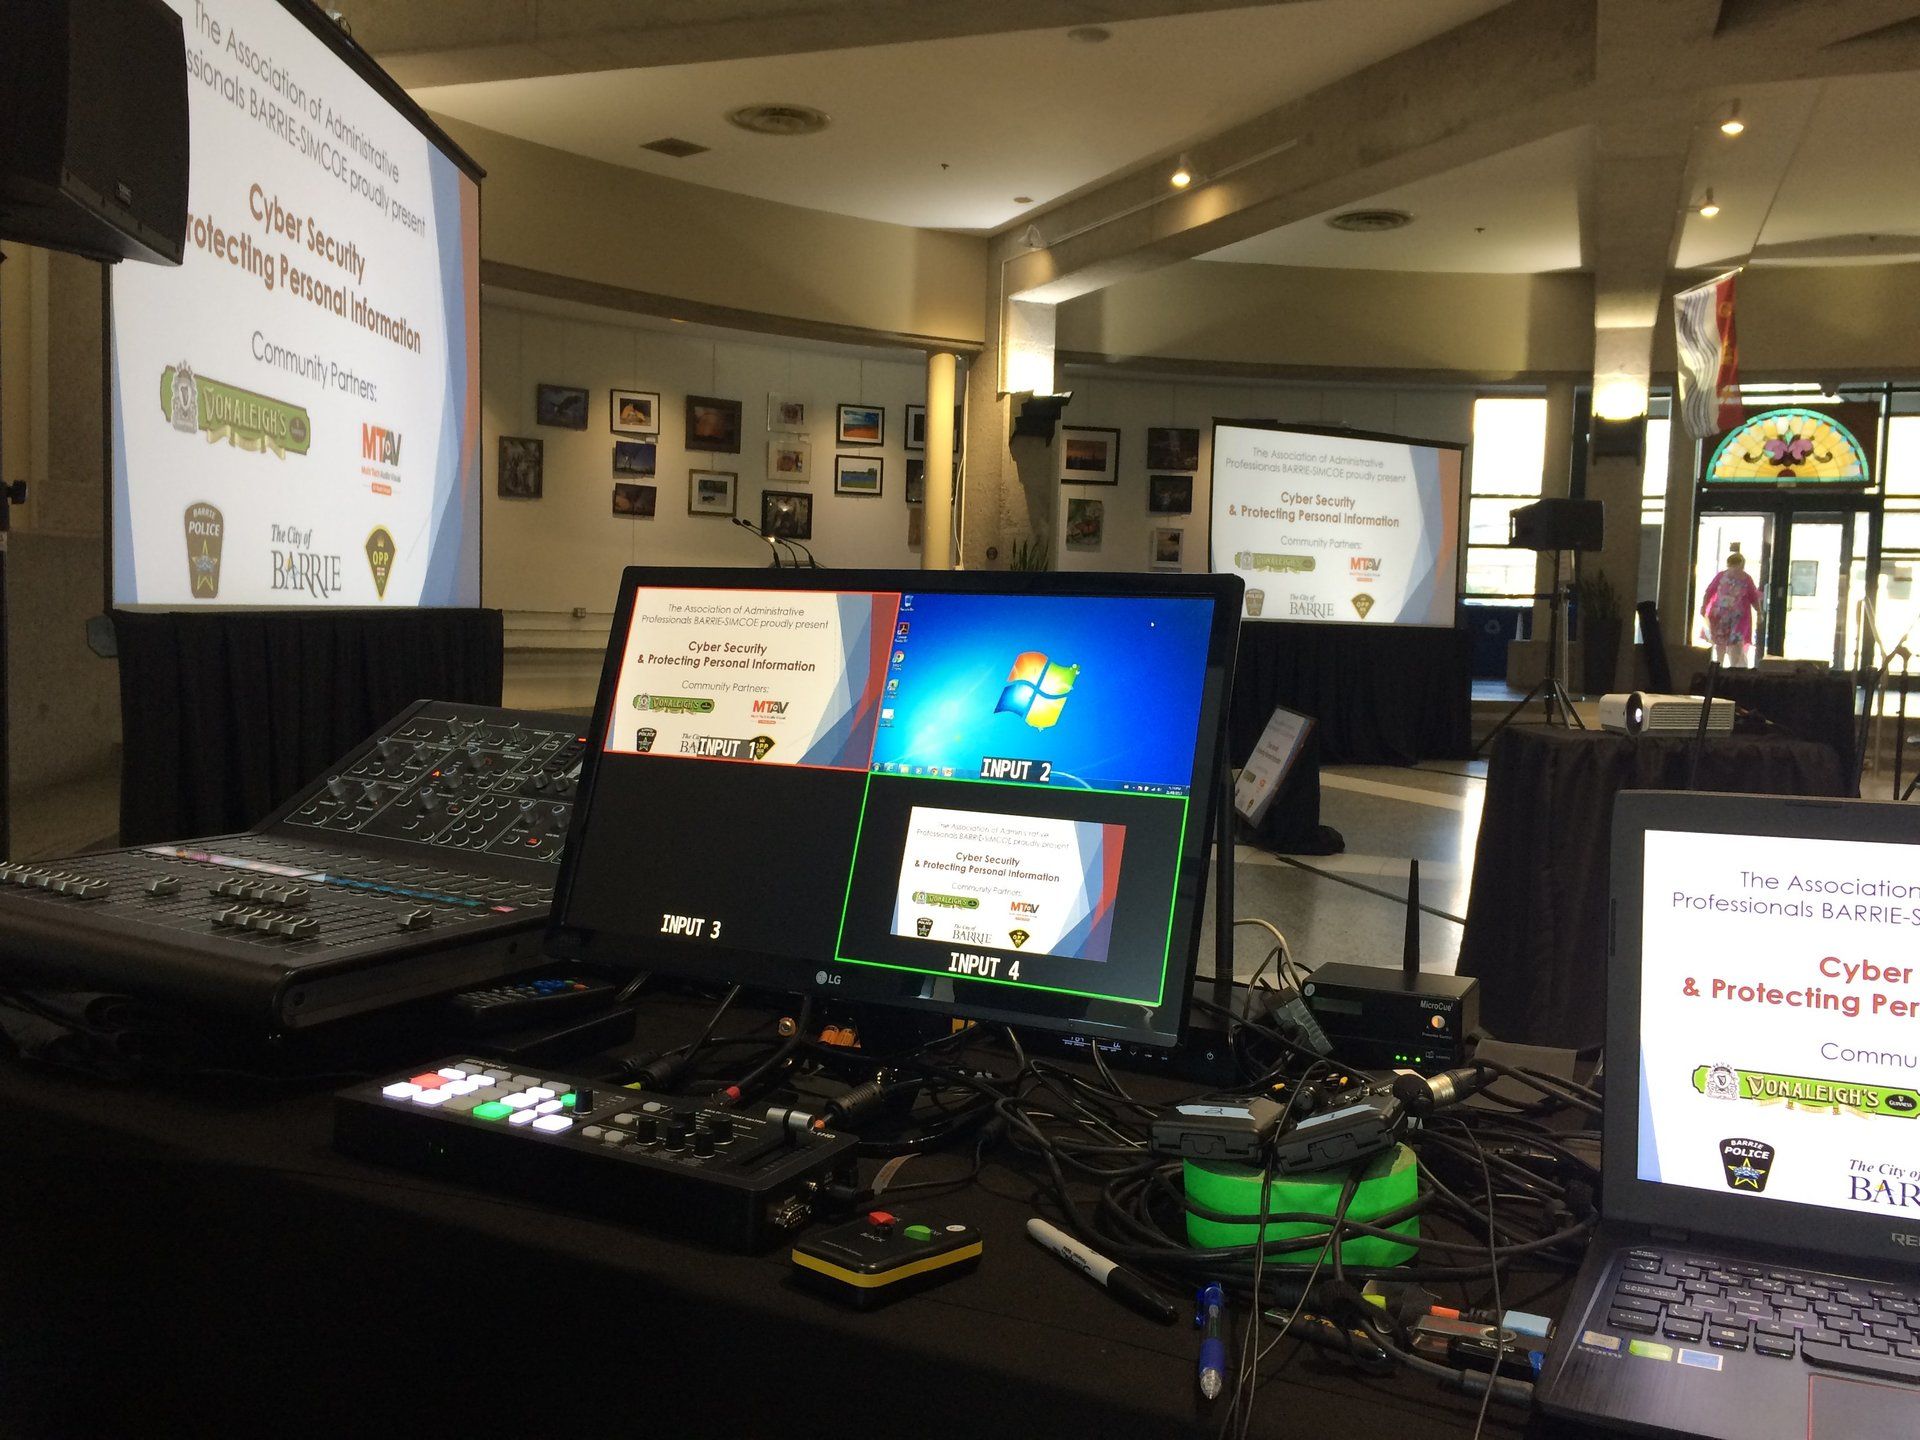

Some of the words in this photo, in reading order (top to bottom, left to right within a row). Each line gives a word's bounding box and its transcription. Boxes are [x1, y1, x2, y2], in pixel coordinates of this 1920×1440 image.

[194, 0, 221, 45] The
[226, 28, 307, 112] Association
[309, 98, 322, 124] of
[325, 108, 400, 184] Administrative
[250, 87, 348, 184] BARRIE-SIMCOE
[350, 169, 390, 217] proudly
[391, 199, 426, 239] present
[249, 182, 303, 244] Cyber
[307, 216, 366, 285] Security
[280, 253, 347, 318] Personal
[350, 290, 421, 355] Information
[251, 330, 328, 390] Community
[331, 361, 377, 403] Partners:
[362, 422, 402, 467] MTAV
[1253, 447, 1269, 458] The
[1271, 449, 1318, 463] Association
[1319, 453, 1328, 463] of
[1330, 455, 1384, 469] Administrative
[1225, 458, 1281, 473] Professionals
[1282, 464, 1345, 479] BARRIE-SIMCOE
[1346, 469, 1376, 482] proudly
[1377, 473, 1406, 483] present
[1280, 491, 1314, 506] Cyber
[1315, 494, 1356, 510] Security
[1228, 504, 1237, 516] &
[1241, 505, 1296, 523] Protecting
[1298, 509, 1342, 524] Personal
[1344, 513, 1400, 528] Information
[188, 521, 221, 538] POLICE
[270, 524, 287, 543] The
[287, 525, 303, 549] City
[304, 528, 313, 550] of
[1280, 535, 1328, 549] Community
[372, 550, 390, 566] OPP
[1350, 557, 1382, 571] MTAV
[270, 550, 342, 599] BARRIE
[668, 603, 683, 613] The
[684, 604, 732, 615] Association
[733, 605, 744, 615] of
[744, 606, 805, 617] Administrative
[1289, 602, 1335, 619] BARRIE
[641, 614, 693, 626] Professionals
[693, 616, 759, 628] BARRIE-SIMCOE
[760, 618, 793, 630] proudly
[794, 620, 829, 630] present
[688, 640, 721, 654] Cyber
[723, 642, 768, 657] Security
[637, 654, 645, 664] &
[647, 654, 701, 669] Protecting
[703, 656, 750, 669] Personal
[752, 658, 816, 673] Information
[681, 680, 731, 693] Community
[733, 683, 770, 694] Partners:
[752, 700, 790, 714] MTAV
[697, 736, 742, 758] INPUT
[748, 741, 757, 759] 1
[980, 756, 1033, 780] INPUT
[1039, 763, 1051, 782] 2
[955, 851, 983, 864] Cyber
[984, 854, 1020, 868] Security
[914, 859, 921, 867] &
[922, 860, 967, 874] Protecting
[968, 865, 1007, 877] Personal
[1008, 869, 1060, 883] Information
[1740, 871, 1779, 890] The
[1787, 875, 1920, 899] Association
[1010, 901, 1041, 914] MTAV
[1672, 891, 1814, 918] Professionals
[660, 913, 705, 938] INPUT
[709, 920, 722, 939] 3
[952, 929, 993, 944] BARRIE
[948, 951, 1001, 977] INPUT
[1008, 960, 1020, 981] 4
[1819, 955, 1914, 985] Cyber
[828, 973, 842, 985] LG
[1682, 976, 1701, 997] &
[1711, 977, 1861, 1018] Protecting
[1871, 992, 1920, 1018] Per
[1820, 1041, 1918, 1069] Commu
[1724, 1145, 1771, 1160] POLICE
[1730, 1139, 1764, 1150] BARRIE
[1849, 1158, 1875, 1173] The
[1878, 1162, 1906, 1179] City
[1847, 1175, 1920, 1208] BAR
[1891, 1231, 1920, 1248] RE
